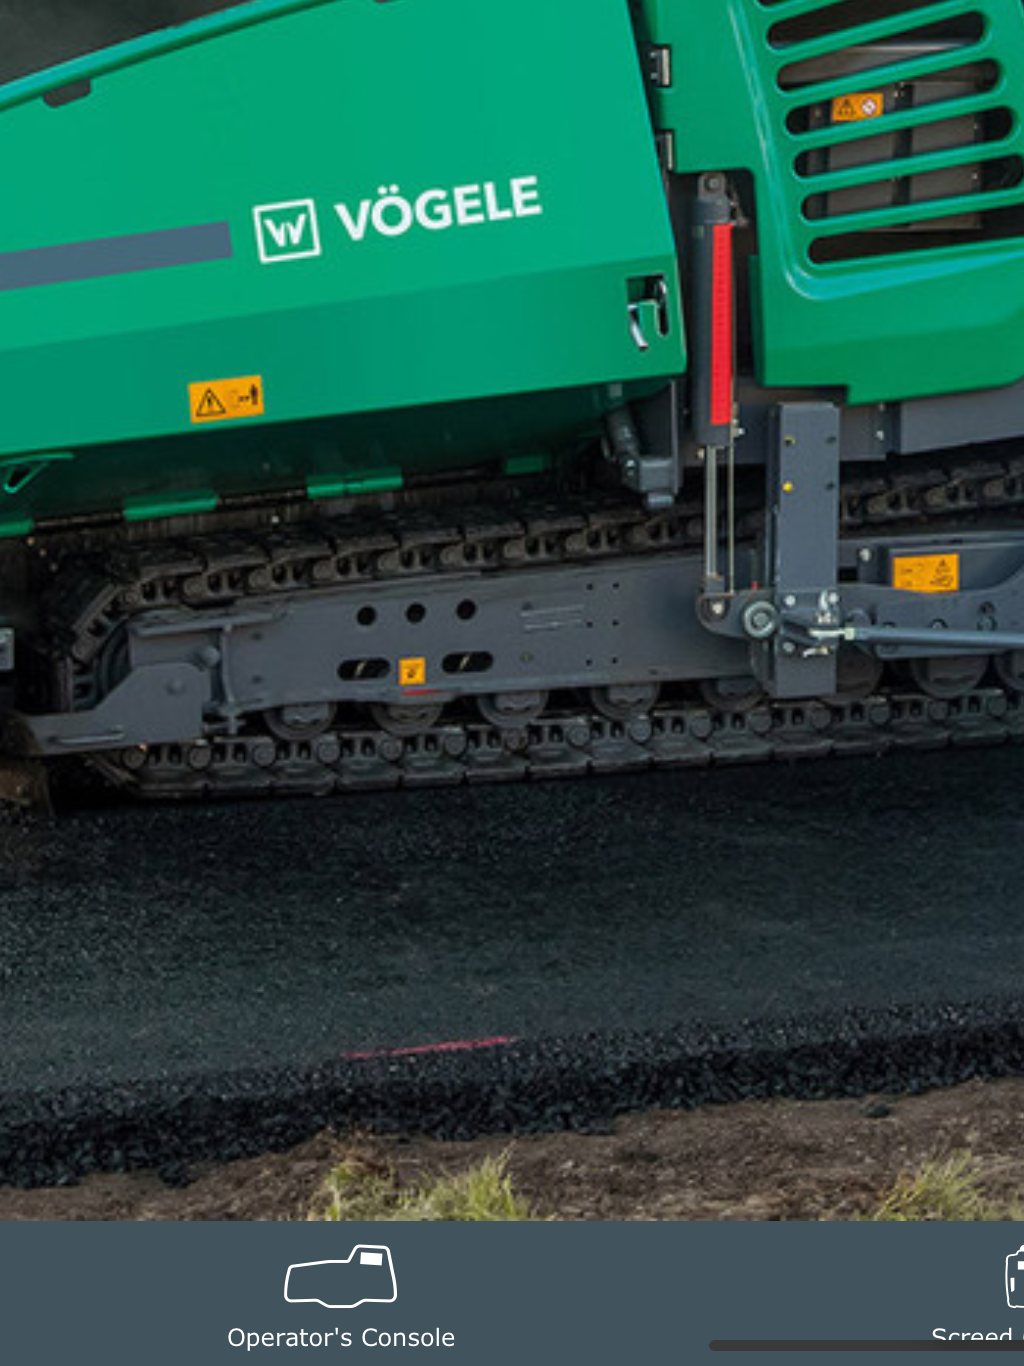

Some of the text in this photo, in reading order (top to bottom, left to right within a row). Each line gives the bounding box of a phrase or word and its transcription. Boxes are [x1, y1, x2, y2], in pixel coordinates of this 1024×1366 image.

[333, 175, 543, 241] VÖGELE
[227, 1327, 455, 1352] Operator's Console
